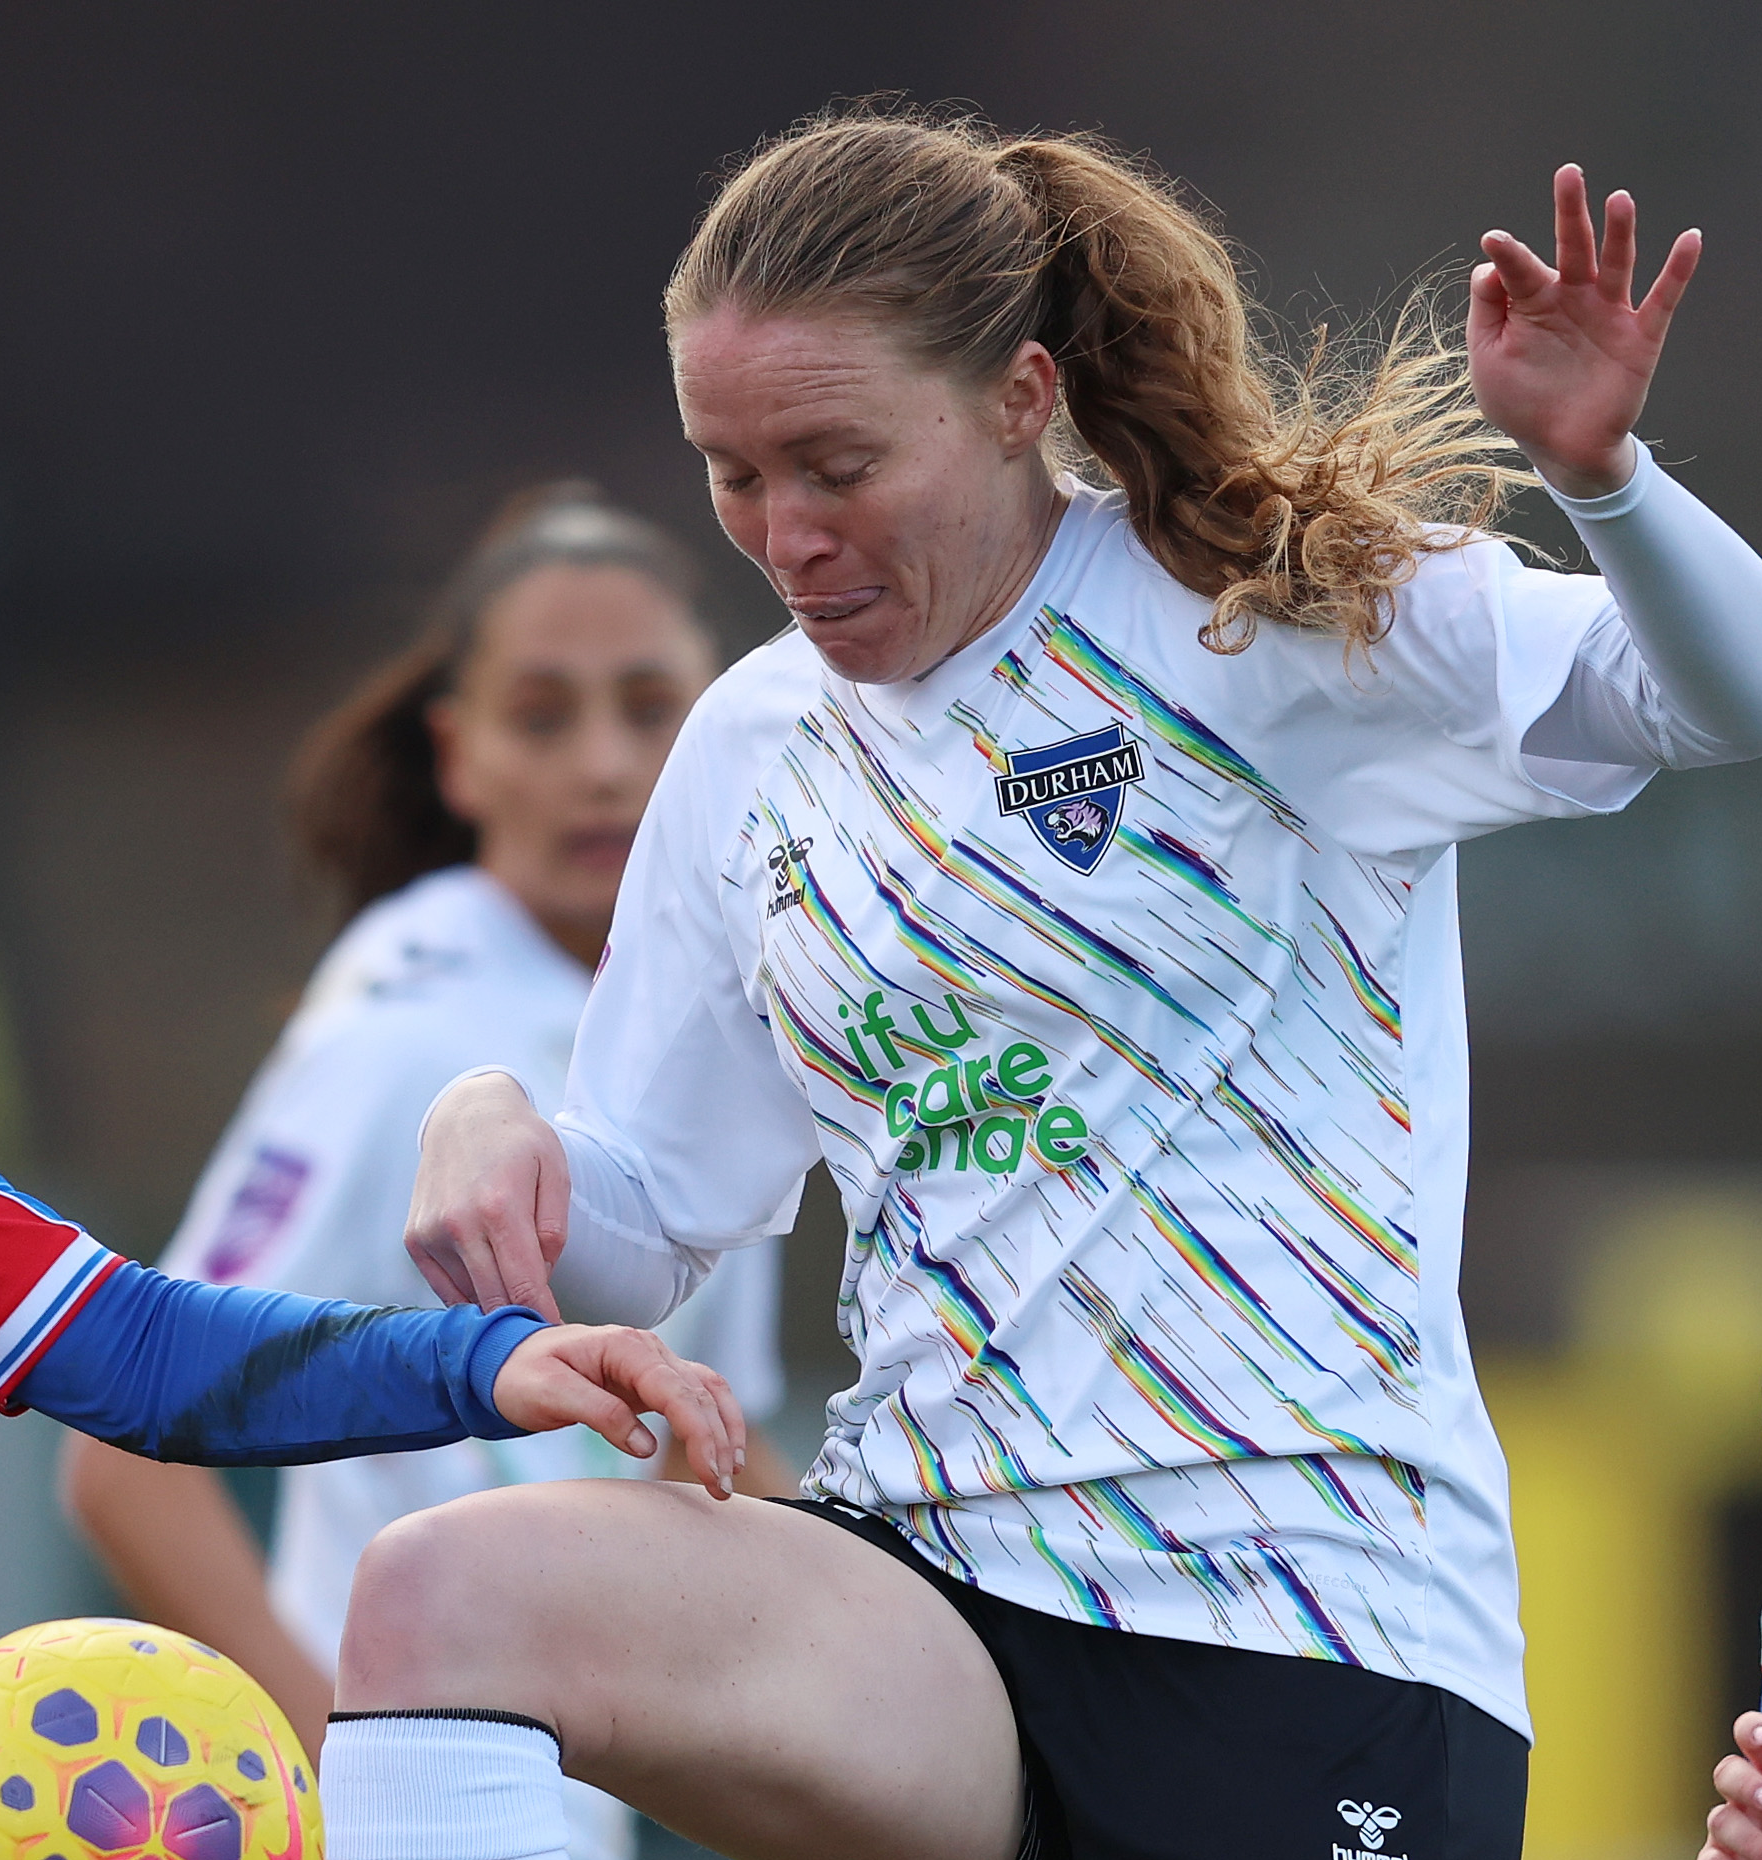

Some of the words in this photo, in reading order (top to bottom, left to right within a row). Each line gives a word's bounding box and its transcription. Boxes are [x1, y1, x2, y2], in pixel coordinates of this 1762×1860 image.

[1007, 752, 1134, 807] DURHAM
[837, 990, 906, 1080] if
[910, 993, 981, 1049] u
[885, 1042, 1054, 1138] care
